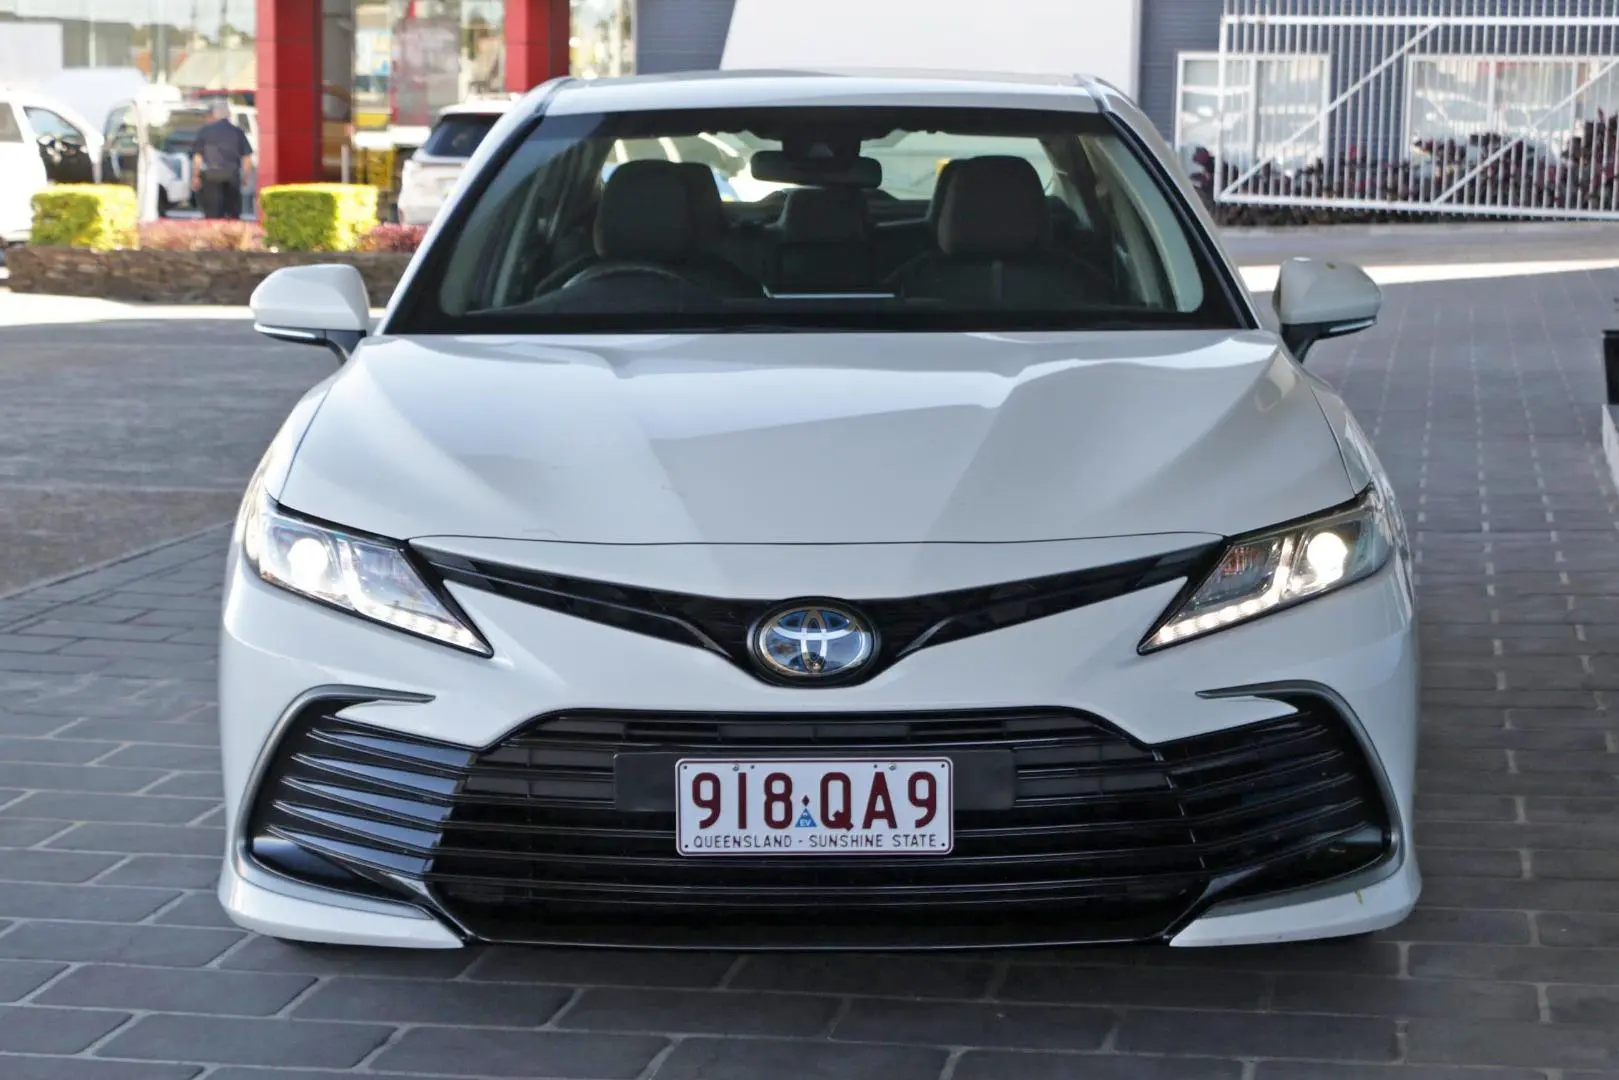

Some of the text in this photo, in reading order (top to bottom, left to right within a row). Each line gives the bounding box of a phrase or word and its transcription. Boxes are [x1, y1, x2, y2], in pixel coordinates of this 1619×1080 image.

[693, 835, 792, 848] QUEENSLAND
[808, 834, 883, 848] SUNSHINE
[892, 834, 937, 848] STATE
